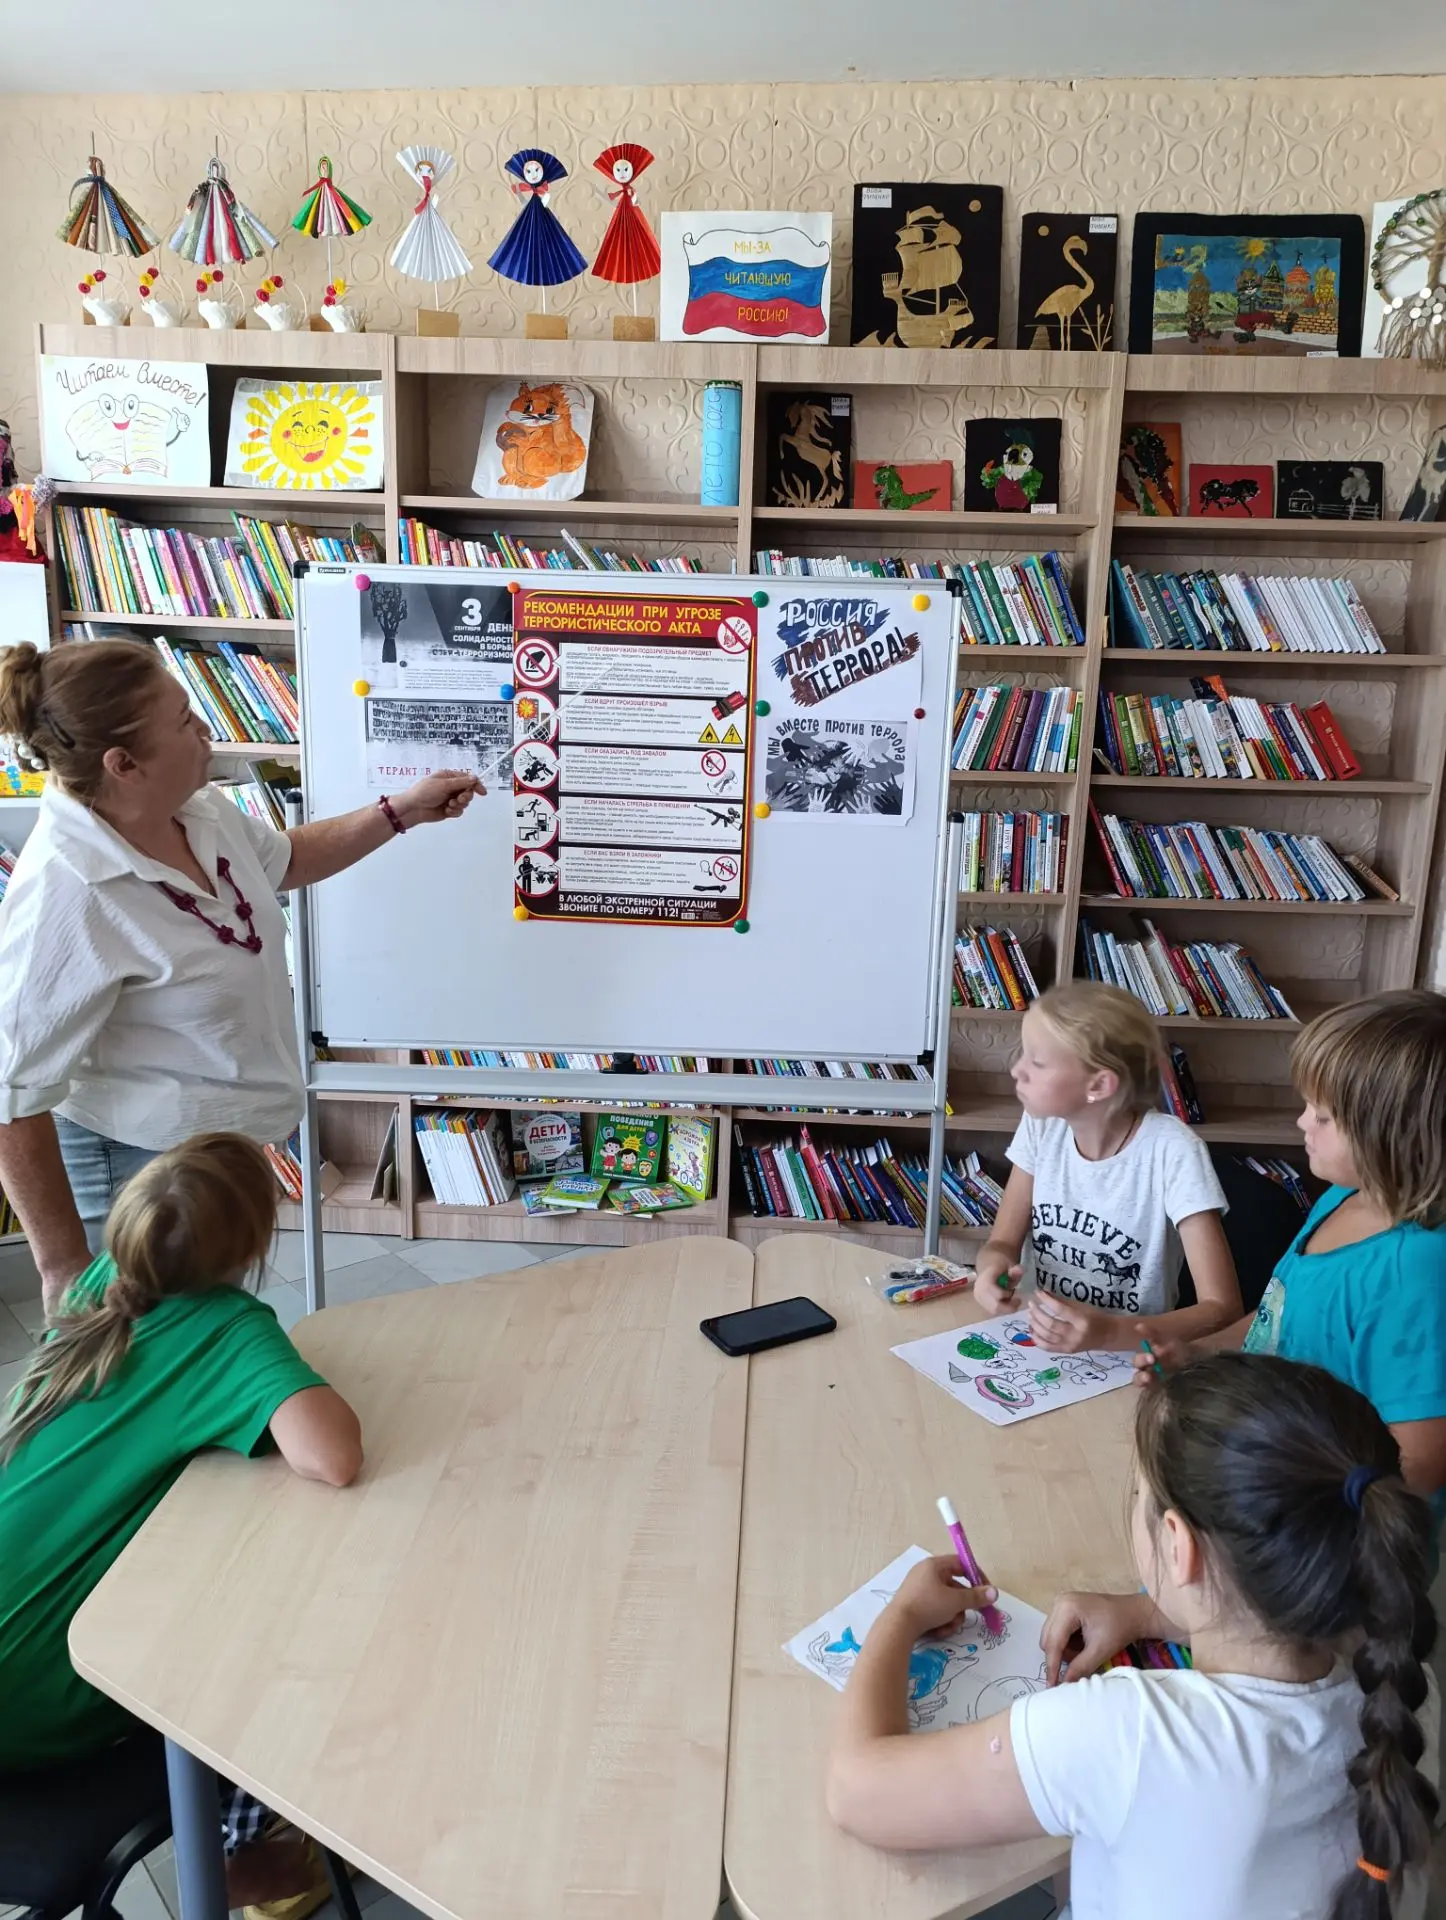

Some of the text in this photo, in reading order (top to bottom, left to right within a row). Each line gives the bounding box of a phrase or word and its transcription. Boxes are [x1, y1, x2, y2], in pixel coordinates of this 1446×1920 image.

[724, 272, 792, 288] ЧИТАЮЩУЮ
[737, 306, 790, 323] РОССИЮ!
[56, 362, 130, 396] Читаем
[461, 598, 483, 626] 3
[524, 601, 722, 620] РЕКОМЕНДАЦИИ ПРИ УГРОЗЕ
[786, 600, 878, 628] РОССИЯ
[523, 615, 702, 634] ТЕРРОРИСТИЧЕСКОГО АКТА
[452, 634, 514, 644] СОЛИДАРНОСТ
[784, 620, 867, 676] ПРОТИВ
[803, 626, 911, 700] ТЕРРОРА!
[824, 719, 864, 736] против
[870, 724, 906, 762] террора
[378, 766, 418, 776] ТЕРАКТ
[425, 768, 432, 776] В
[558, 903, 600, 913] ЗВОНИТЕ
[601, 904, 614, 913] ПО
[616, 905, 655, 915] НОМЕРУ
[657, 907, 679, 917] 112!
[566, 894, 603, 904] ЛЮБОЙ
[604, 896, 665, 907] ЭКСТРЕННОЙ
[666, 899, 717, 910] СИТУАЦИИ
[610, 1115, 654, 1127] ПОВЕДЕНИЯ
[529, 1124, 566, 1139] ДЕТИ
[1032, 1203, 1142, 1260] BELIEVE
[1060, 1244, 1086, 1270] IN
